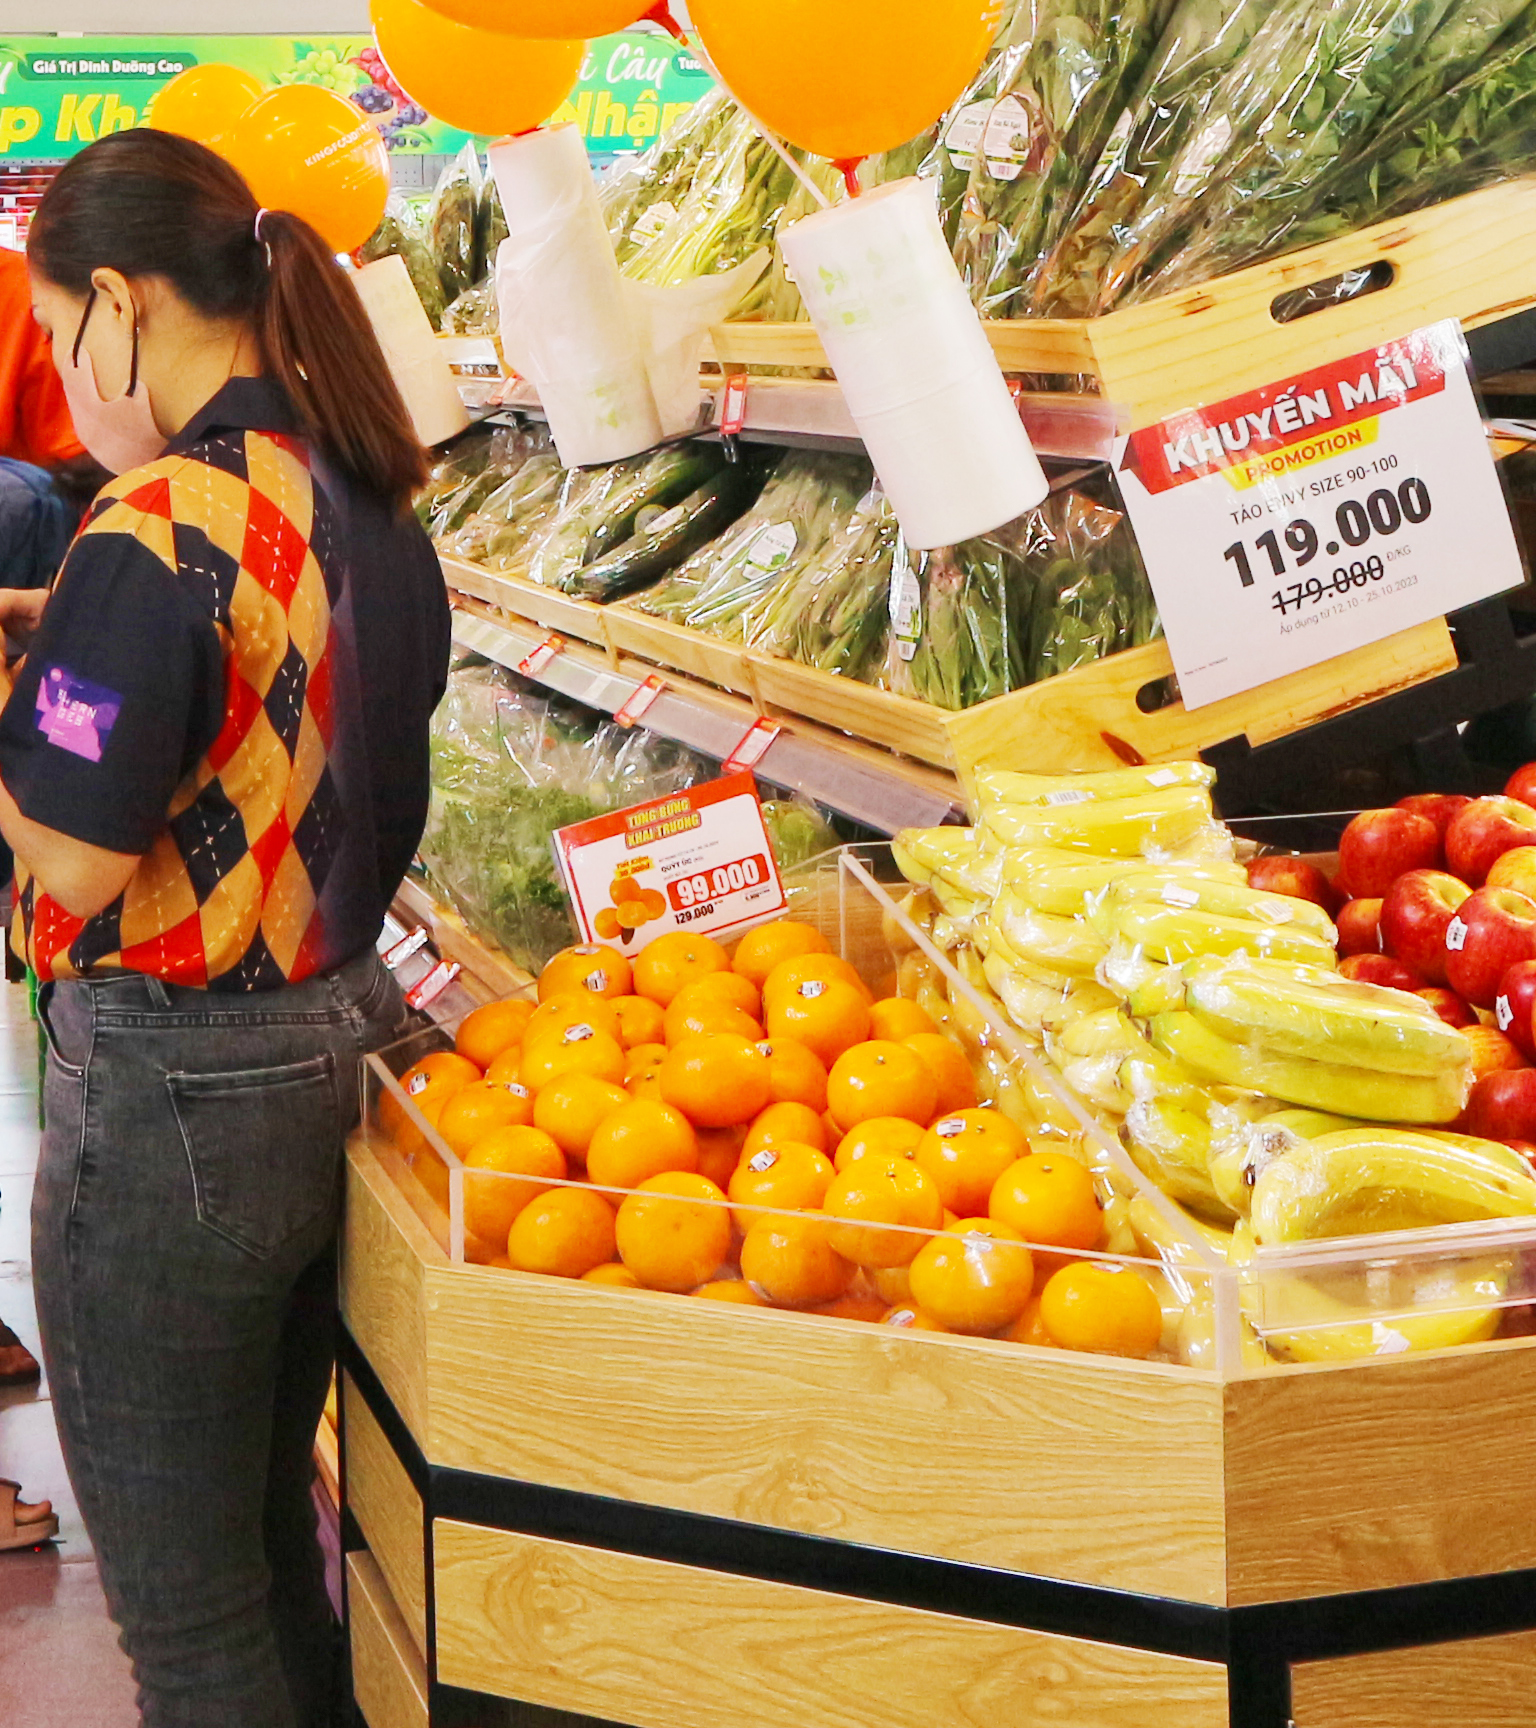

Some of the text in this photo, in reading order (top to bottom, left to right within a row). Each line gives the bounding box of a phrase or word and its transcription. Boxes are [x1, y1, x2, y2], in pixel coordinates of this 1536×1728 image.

[32, 58, 56, 74] Giá
[58, 59, 77, 78] Trị
[79, 58, 115, 74] Dinh
[157, 60, 184, 74] Cao
[605, 42, 669, 90] Cây
[1163, 353, 1418, 473] KHUYẾN MÃI
[1245, 428, 1363, 483] PROMOTION
[1230, 502, 1262, 526] TÁO
[1310, 475, 1344, 499] SIZE
[1346, 453, 1399, 485] 90-100
[1223, 476, 1433, 589] 119.000
[1271, 555, 1385, 616] 179.000
[676, 858, 760, 906] 99.000
[674, 903, 715, 925] 129.000
